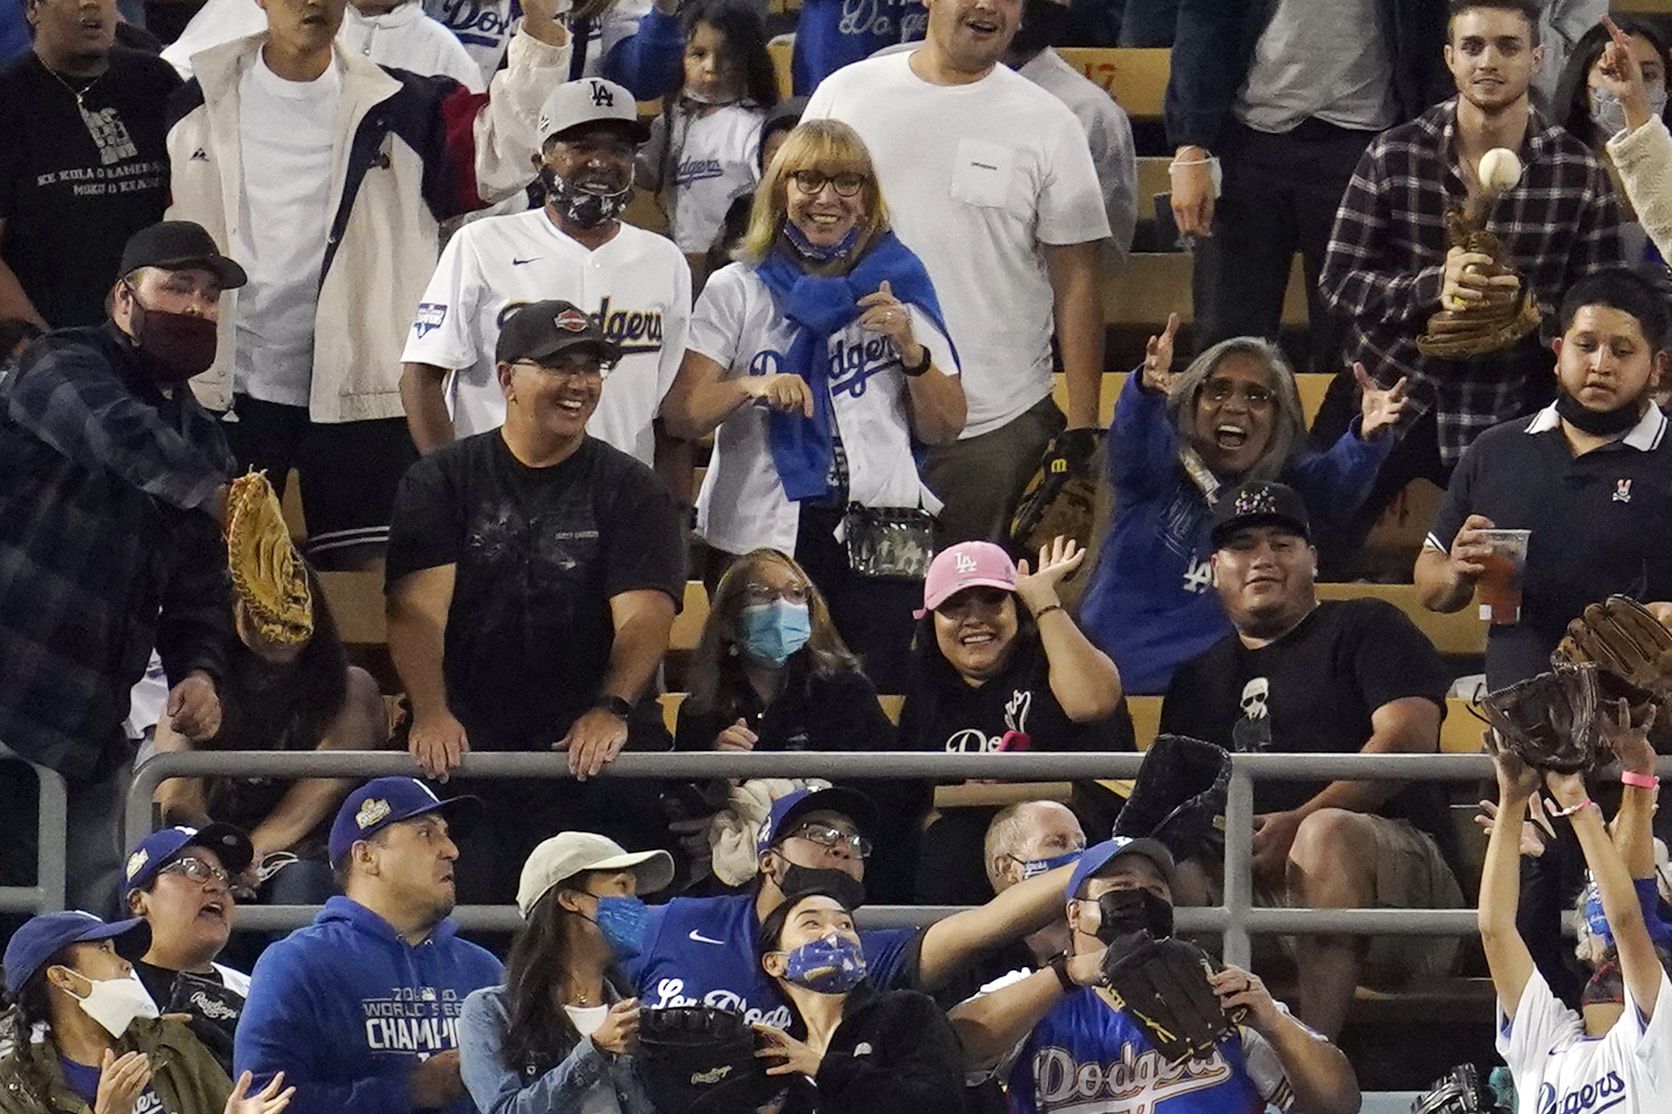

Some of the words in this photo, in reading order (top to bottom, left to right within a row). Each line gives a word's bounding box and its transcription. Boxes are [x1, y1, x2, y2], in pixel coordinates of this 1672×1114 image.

[590, 80, 613, 107] LA
[672, 157, 724, 190] dgers
[954, 551, 978, 574] LA
[189, 990, 239, 1021] Rawlings
[363, 1002, 426, 1017] WORLD
[431, 1002, 462, 1018] SER
[366, 1017, 462, 1051] CHAMPI
